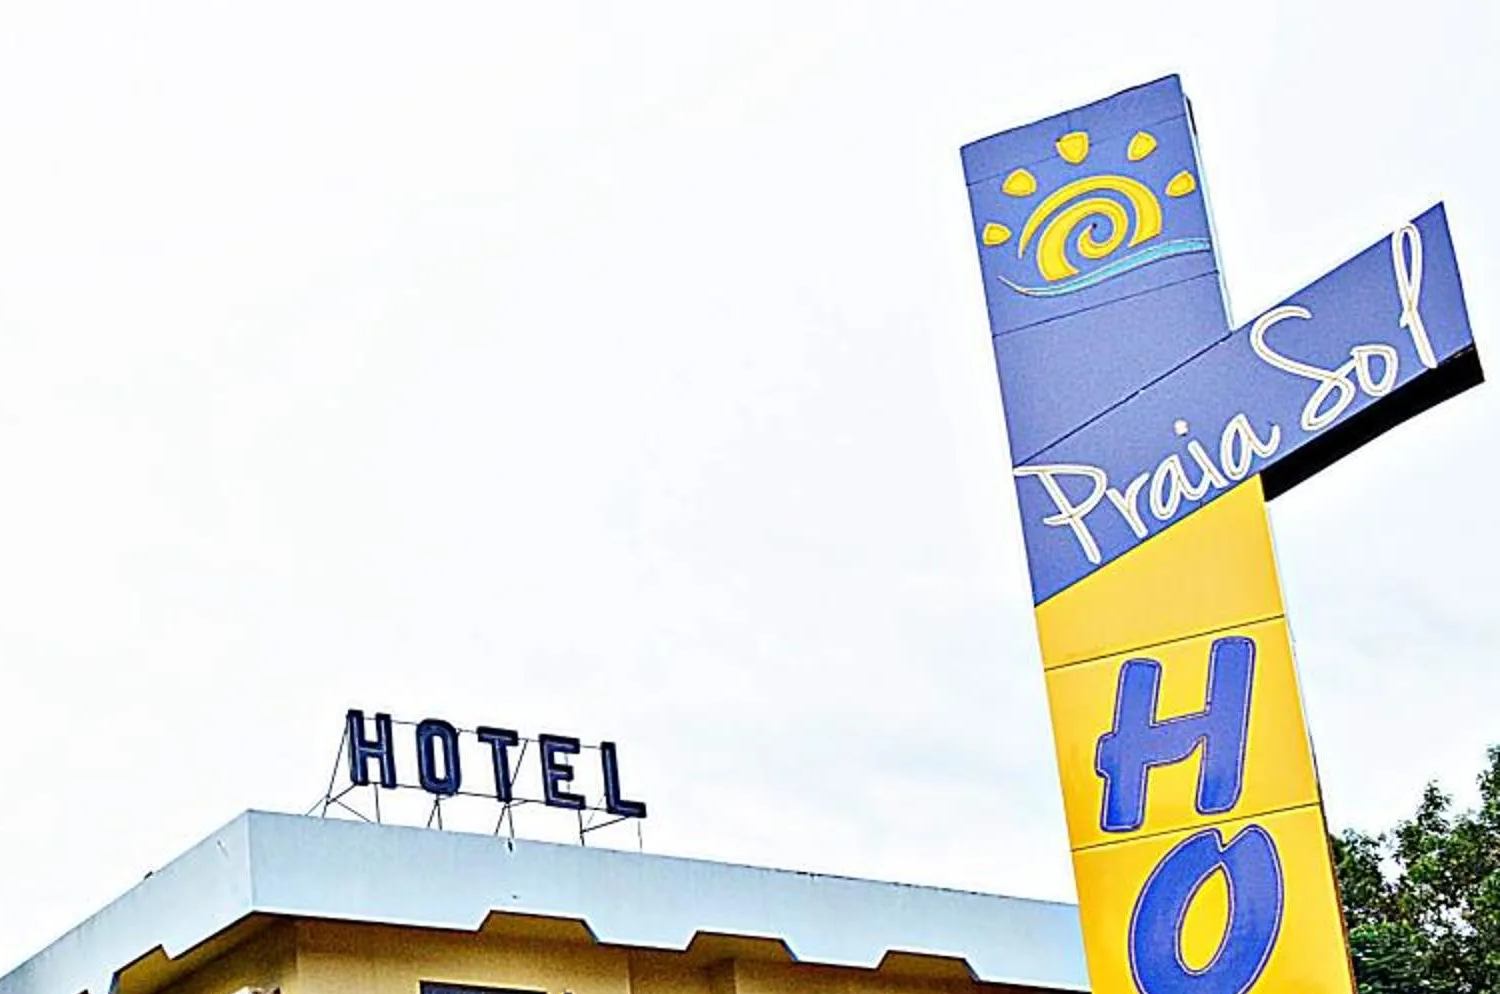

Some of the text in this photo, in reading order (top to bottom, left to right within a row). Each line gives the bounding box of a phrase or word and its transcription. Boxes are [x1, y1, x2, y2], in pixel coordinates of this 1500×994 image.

[1012, 220, 1438, 564] Praia Sol
[347, 709, 647, 818] HOTEL
